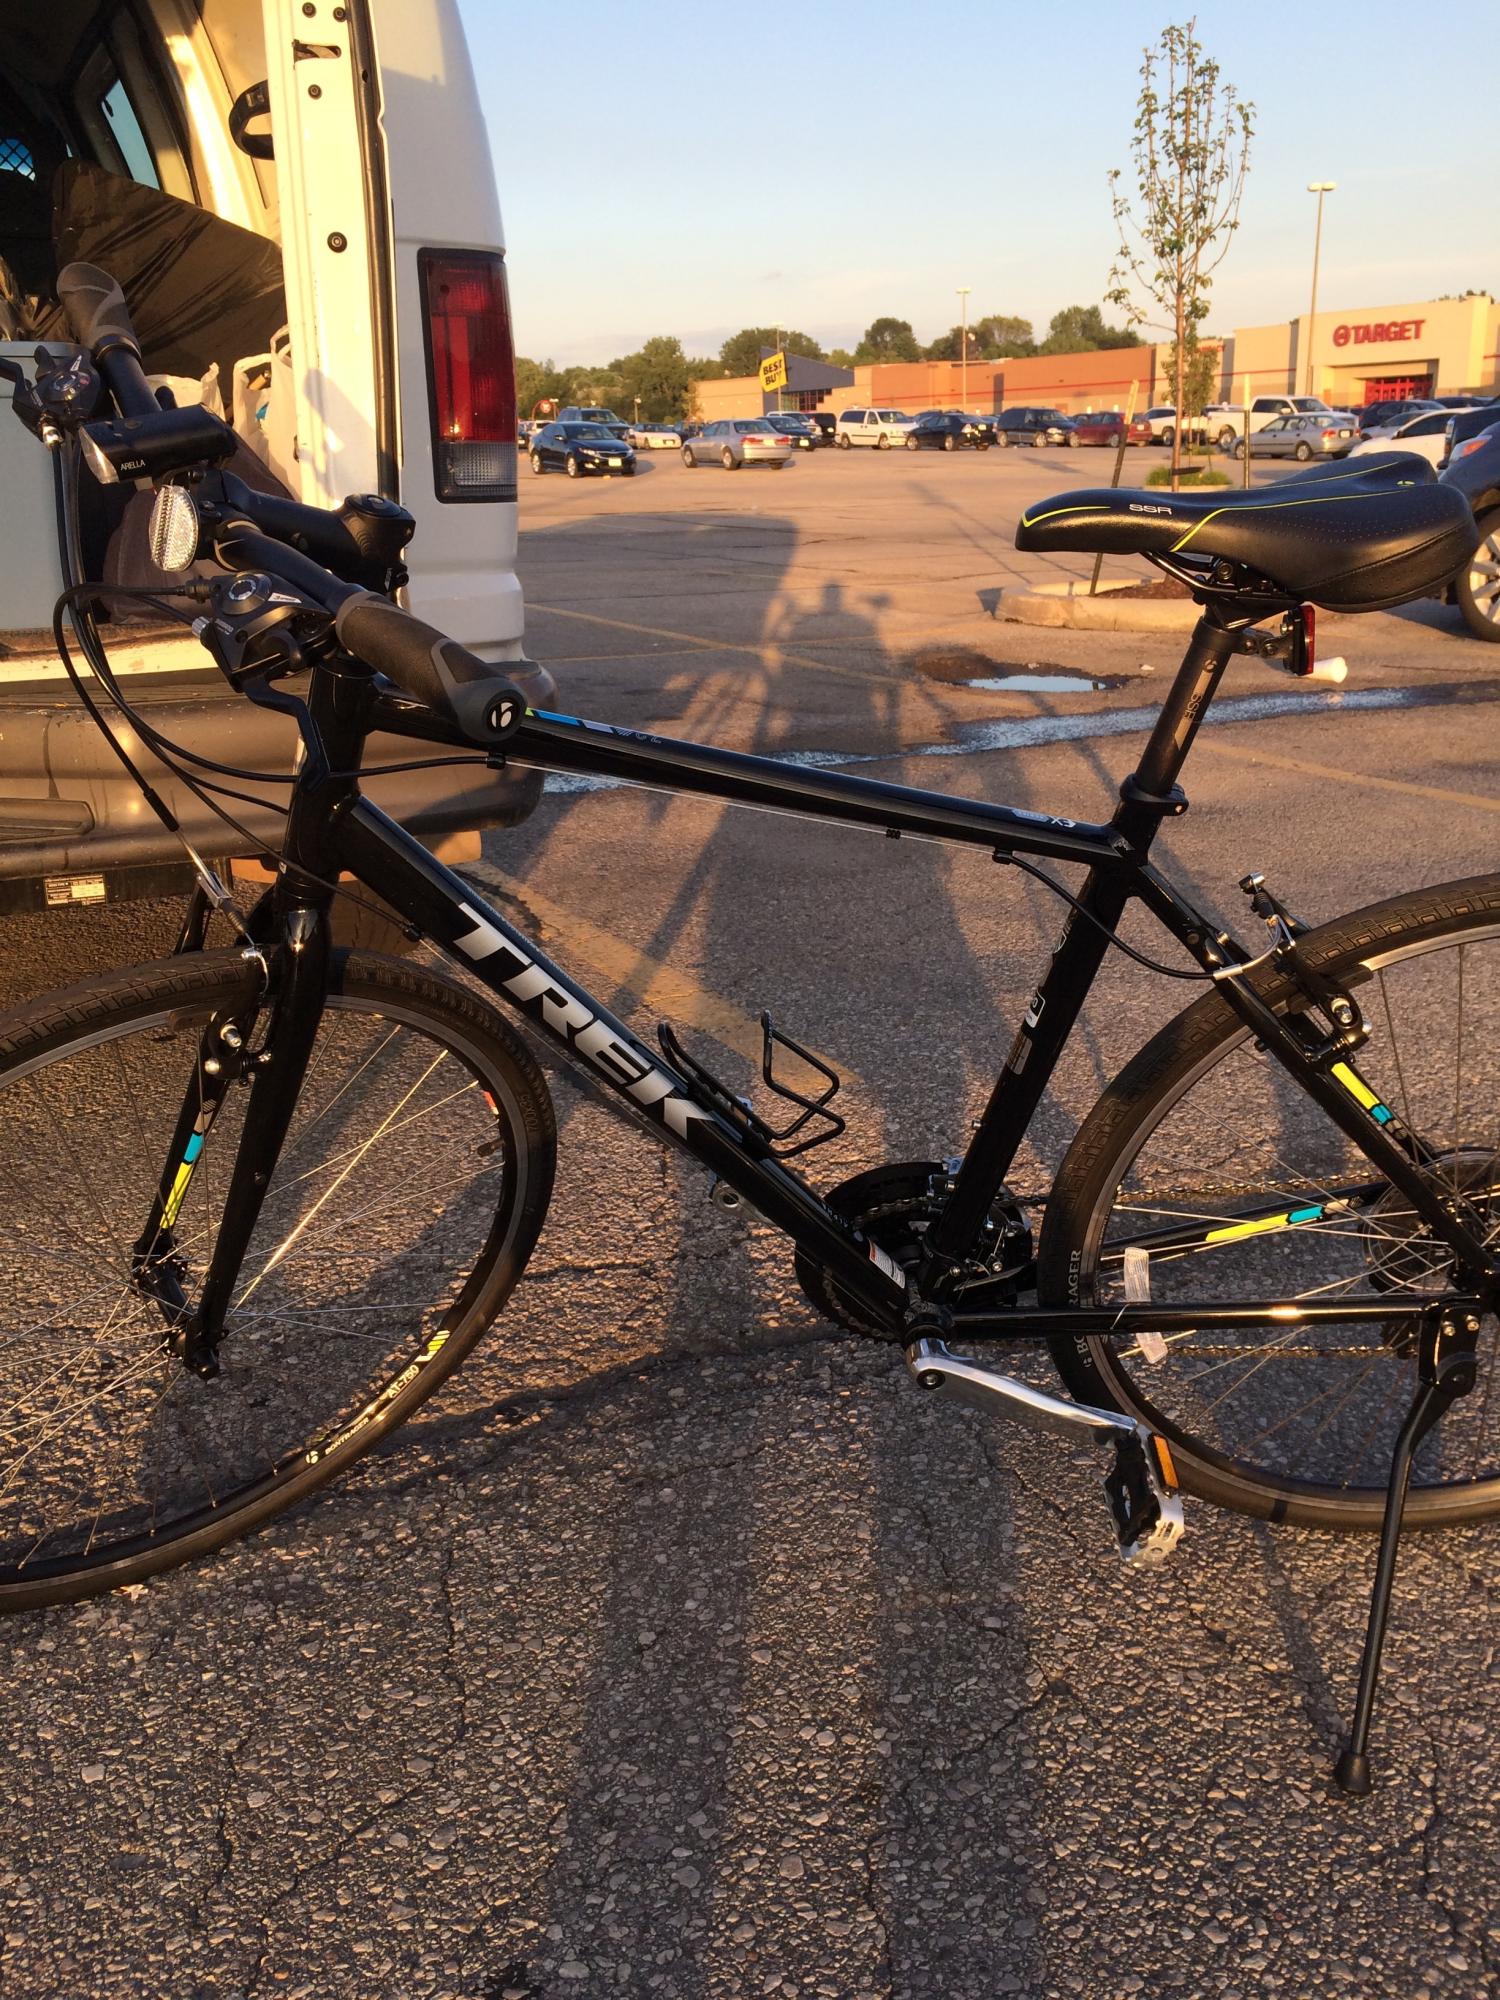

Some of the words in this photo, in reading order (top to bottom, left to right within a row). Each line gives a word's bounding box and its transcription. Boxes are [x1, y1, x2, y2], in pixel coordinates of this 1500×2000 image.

[1351, 319, 1426, 344] TARGET
[762, 359, 782, 375] BEST
[1129, 503, 1173, 515] SSR
[453, 902, 716, 1140] TREK
[386, 1364, 420, 1398] AT-750
[324, 1417, 369, 1455] BONTRAGER
